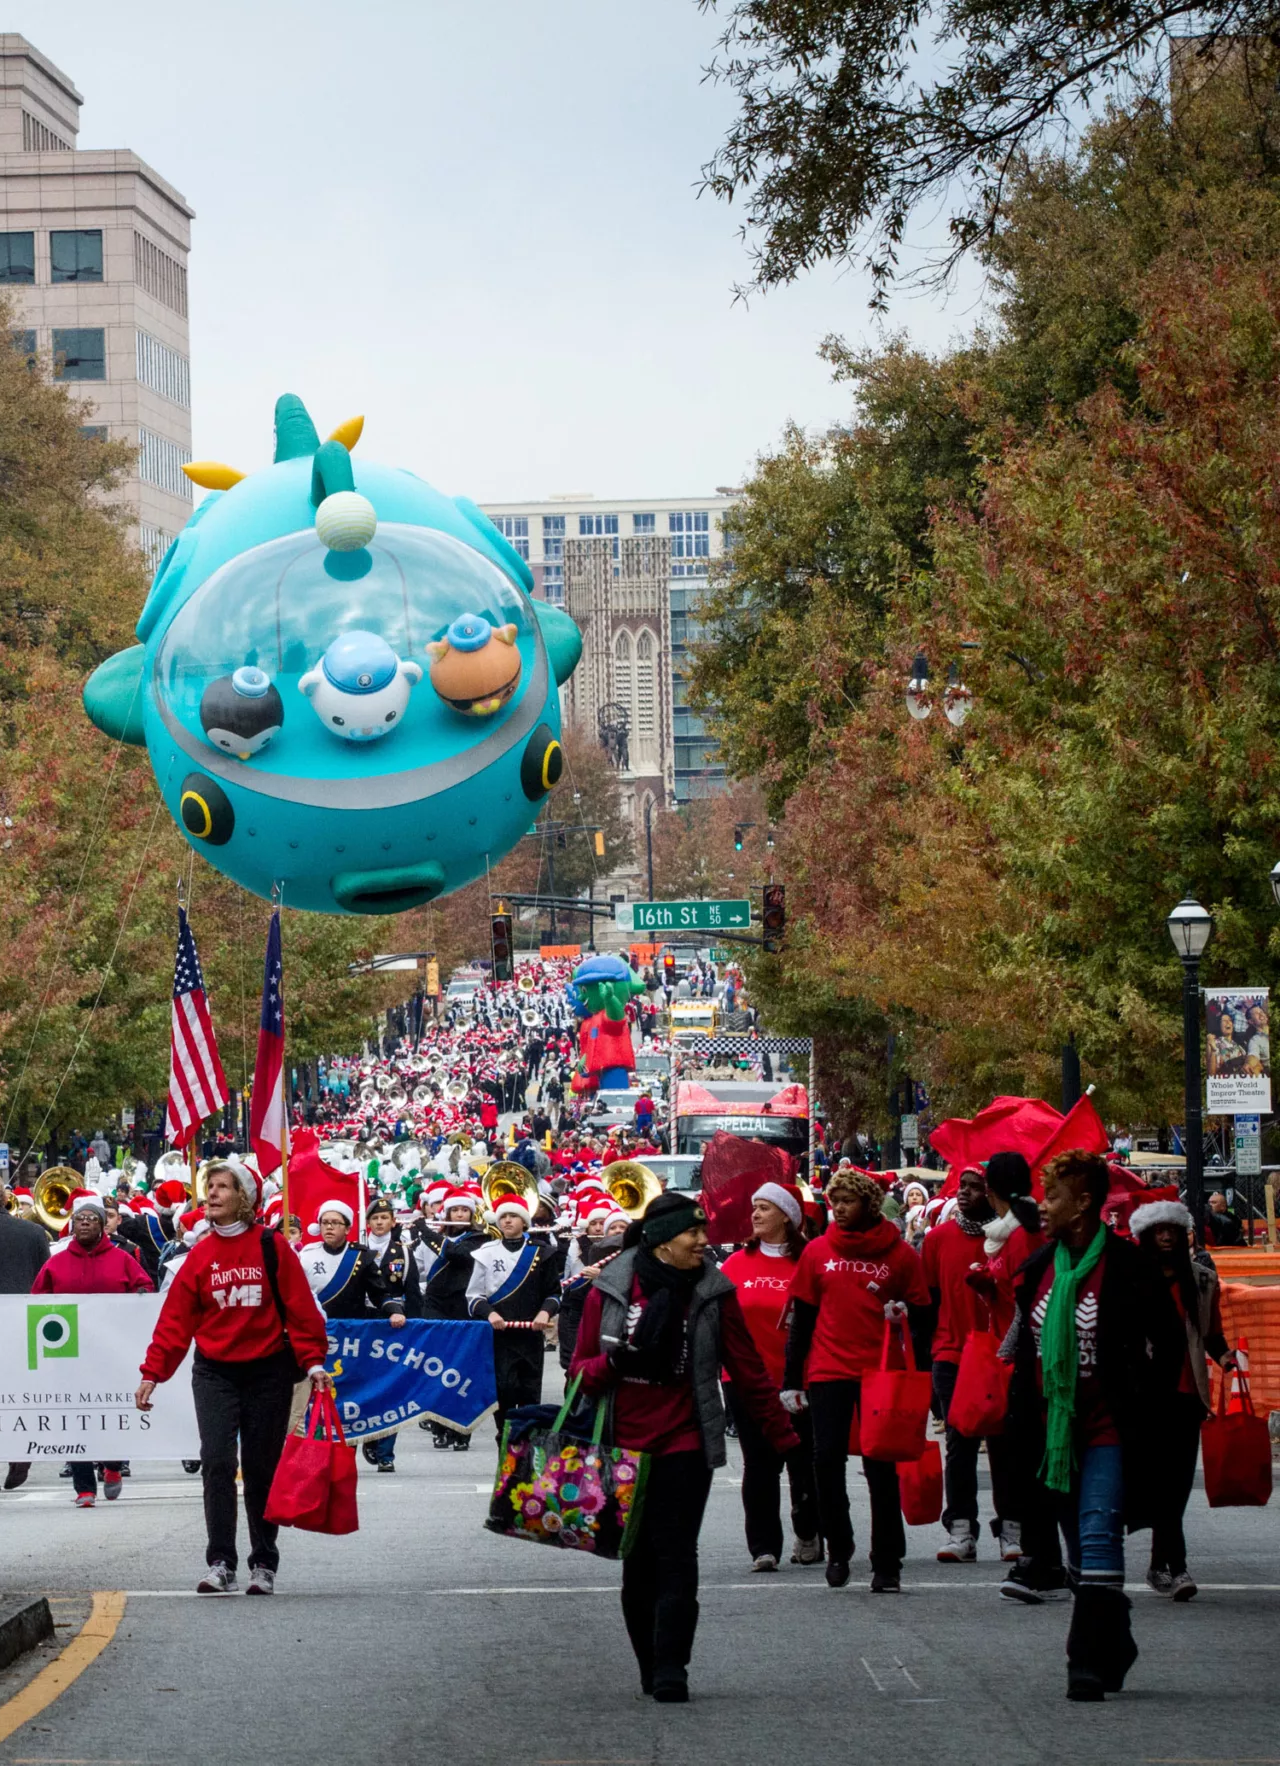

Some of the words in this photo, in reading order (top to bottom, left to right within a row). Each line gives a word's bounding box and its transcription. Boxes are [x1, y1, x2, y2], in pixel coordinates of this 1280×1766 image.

[638, 907, 673, 926] 16th
[680, 906, 698, 925] St
[709, 905, 721, 914] NE
[709, 915, 722, 925] 50
[1211, 1081, 1234, 1089] Whole
[716, 1118, 770, 1131] SPECIAL
[838, 1258, 890, 1279] macy's
[211, 1266, 263, 1286] PARTNERS
[754, 1278, 791, 1290] mac
[212, 1284, 263, 1310] TME
[326, 1335, 361, 1358] GH
[369, 1338, 473, 1398] SCHOOL
[22, 1391, 72, 1404] SUPER
[79, 1391, 133, 1404] MARKE
[26, 1441, 87, 1455] Presents
